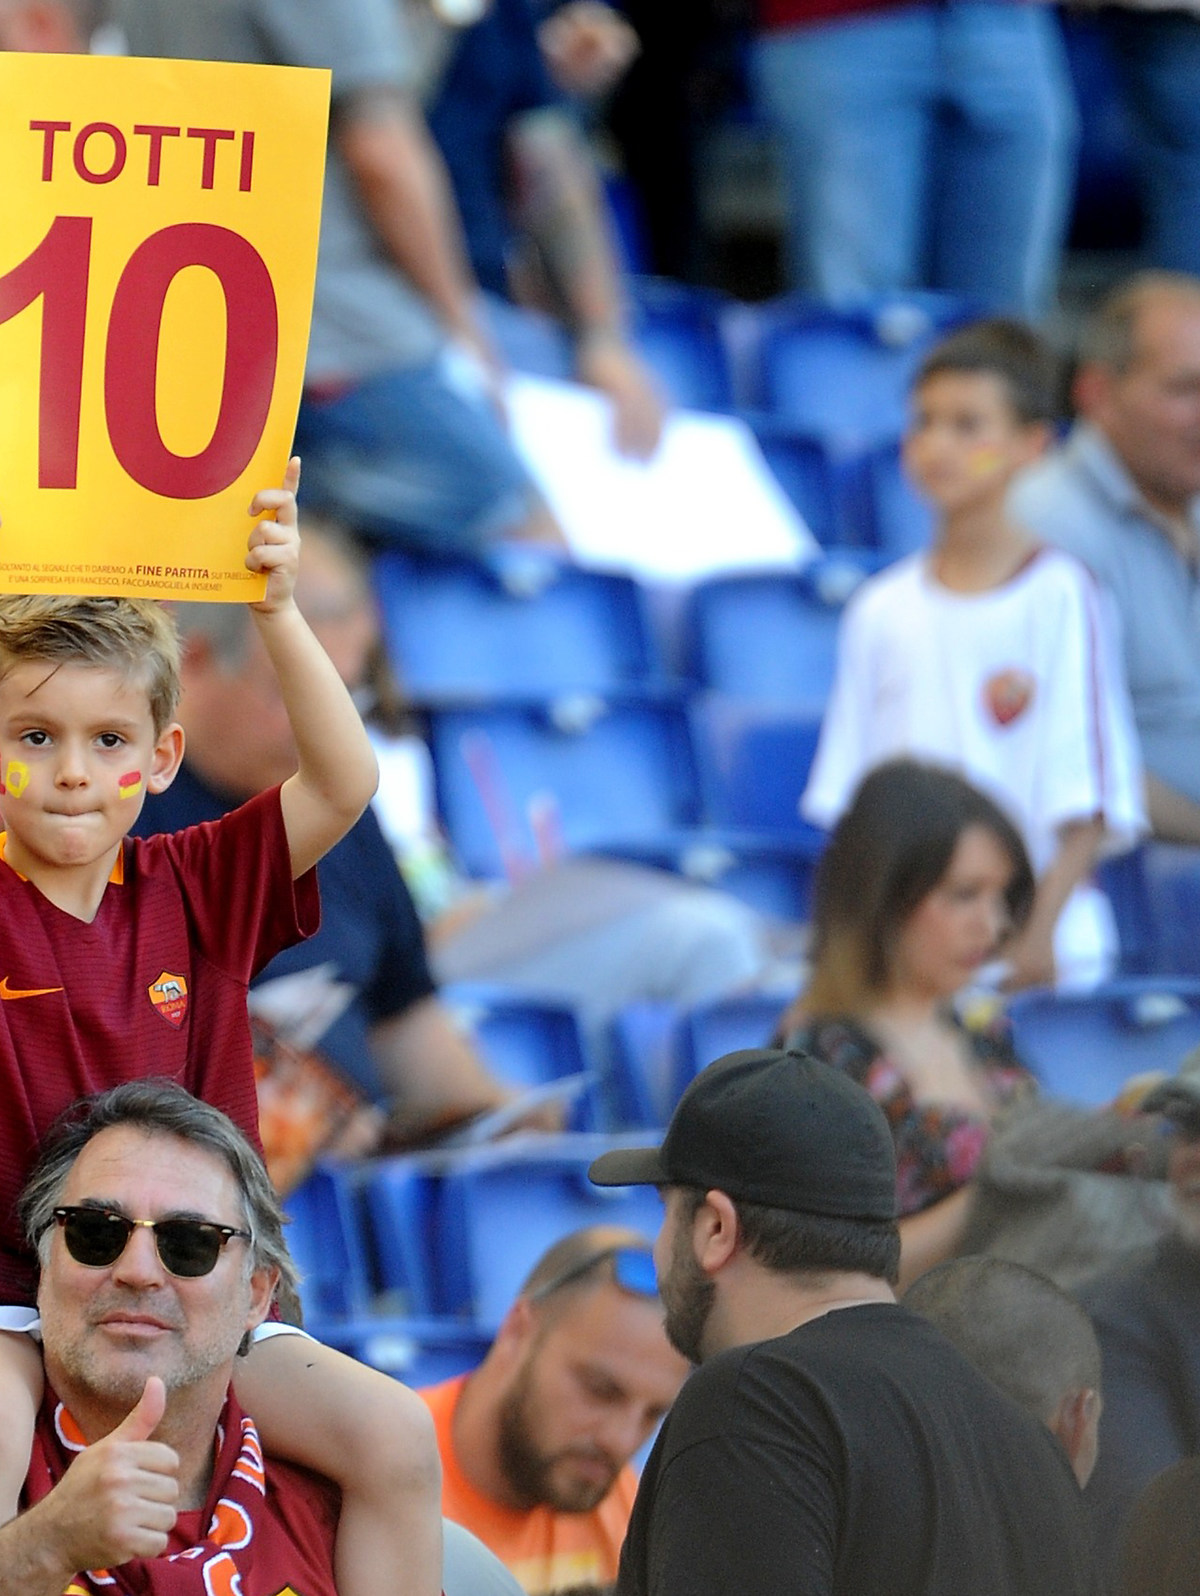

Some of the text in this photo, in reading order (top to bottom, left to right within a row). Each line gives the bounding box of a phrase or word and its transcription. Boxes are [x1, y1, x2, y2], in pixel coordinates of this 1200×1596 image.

[29, 119, 255, 192] TOTTI
[0, 563, 31, 572] SOLTANTO
[42, 564, 69, 573] SEGNALE
[70, 564, 83, 573] CHE
[91, 565, 126, 575] DAREMO
[127, 566, 134, 575] A
[135, 565, 162, 577] FINE
[165, 567, 209, 579] PARTITA
[15, 575, 29, 583] UNA
[30, 575, 62, 584] SORPRESA
